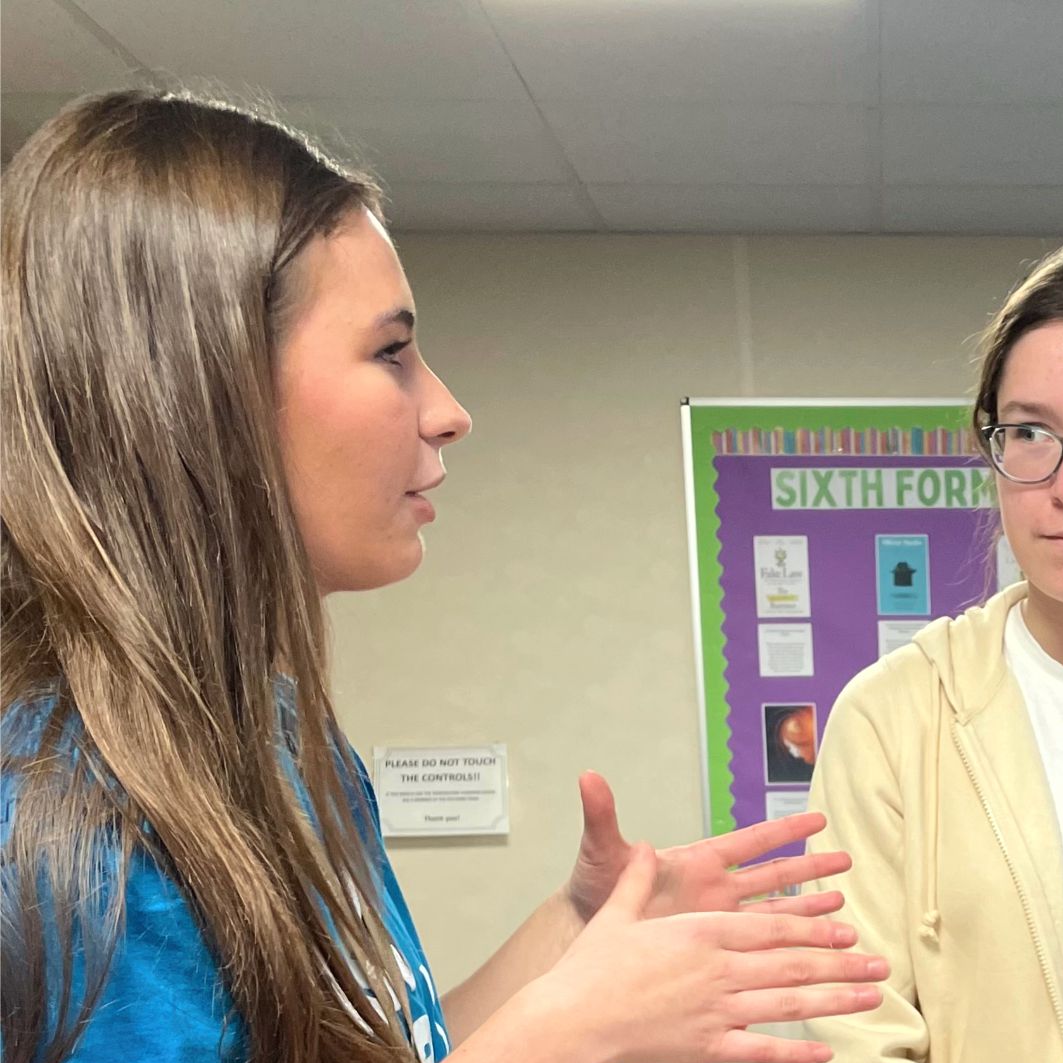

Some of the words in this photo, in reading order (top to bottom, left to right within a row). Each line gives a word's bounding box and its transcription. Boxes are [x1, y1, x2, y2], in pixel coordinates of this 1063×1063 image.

[774, 469, 884, 507] SIXTH
[385, 759, 419, 768] PLEASE
[422, 759, 436, 767] DO
[440, 758, 460, 767] NOT
[463, 757, 496, 766] TOUCH
[400, 774, 419, 782] THE
[422, 772, 480, 782] CONTROLS!!
